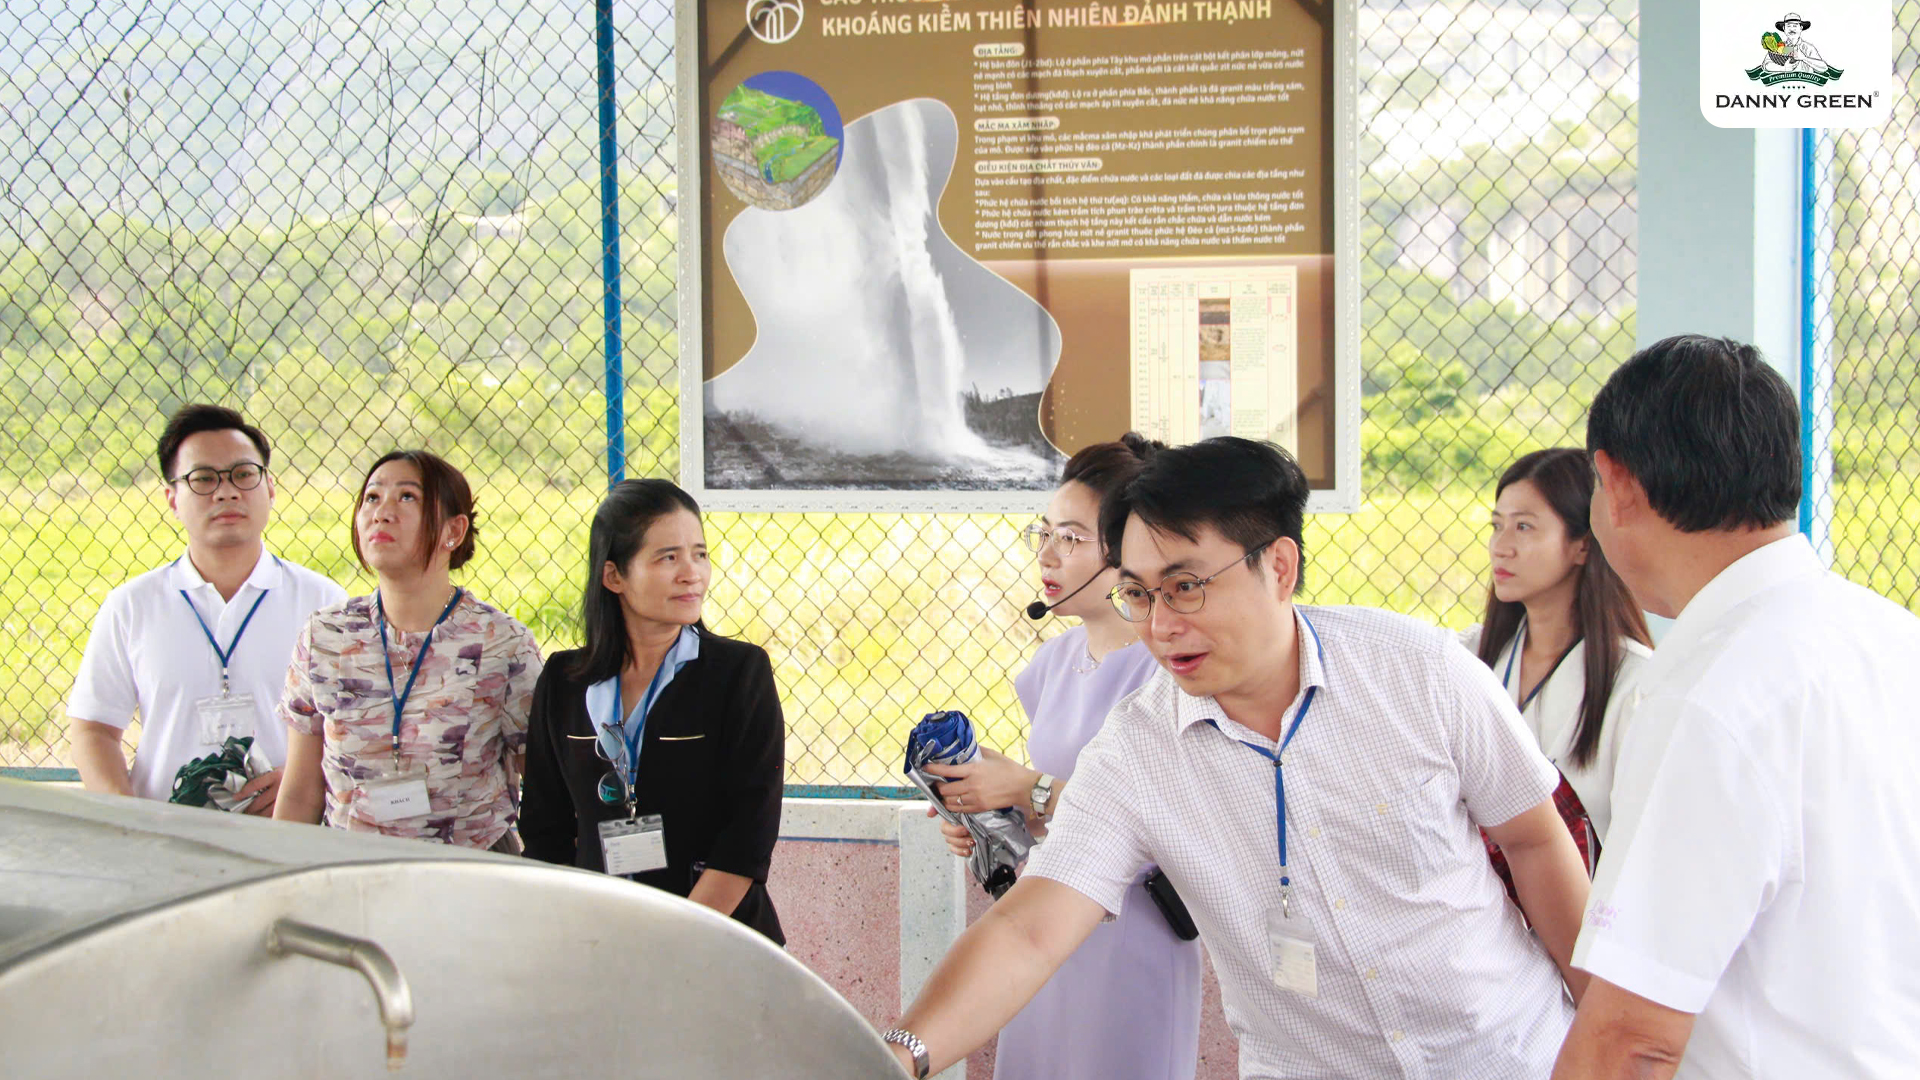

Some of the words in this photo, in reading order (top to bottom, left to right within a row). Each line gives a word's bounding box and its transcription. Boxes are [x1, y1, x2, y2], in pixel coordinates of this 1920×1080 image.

[821, 11, 912, 37] KHOÁNG
[918, 3, 971, 33] KIỀM
[976, 5, 1041, 30] THIÊN
[1048, 1, 1117, 28] NHIÊN
[1194, 0, 1272, 25] THẠNH
